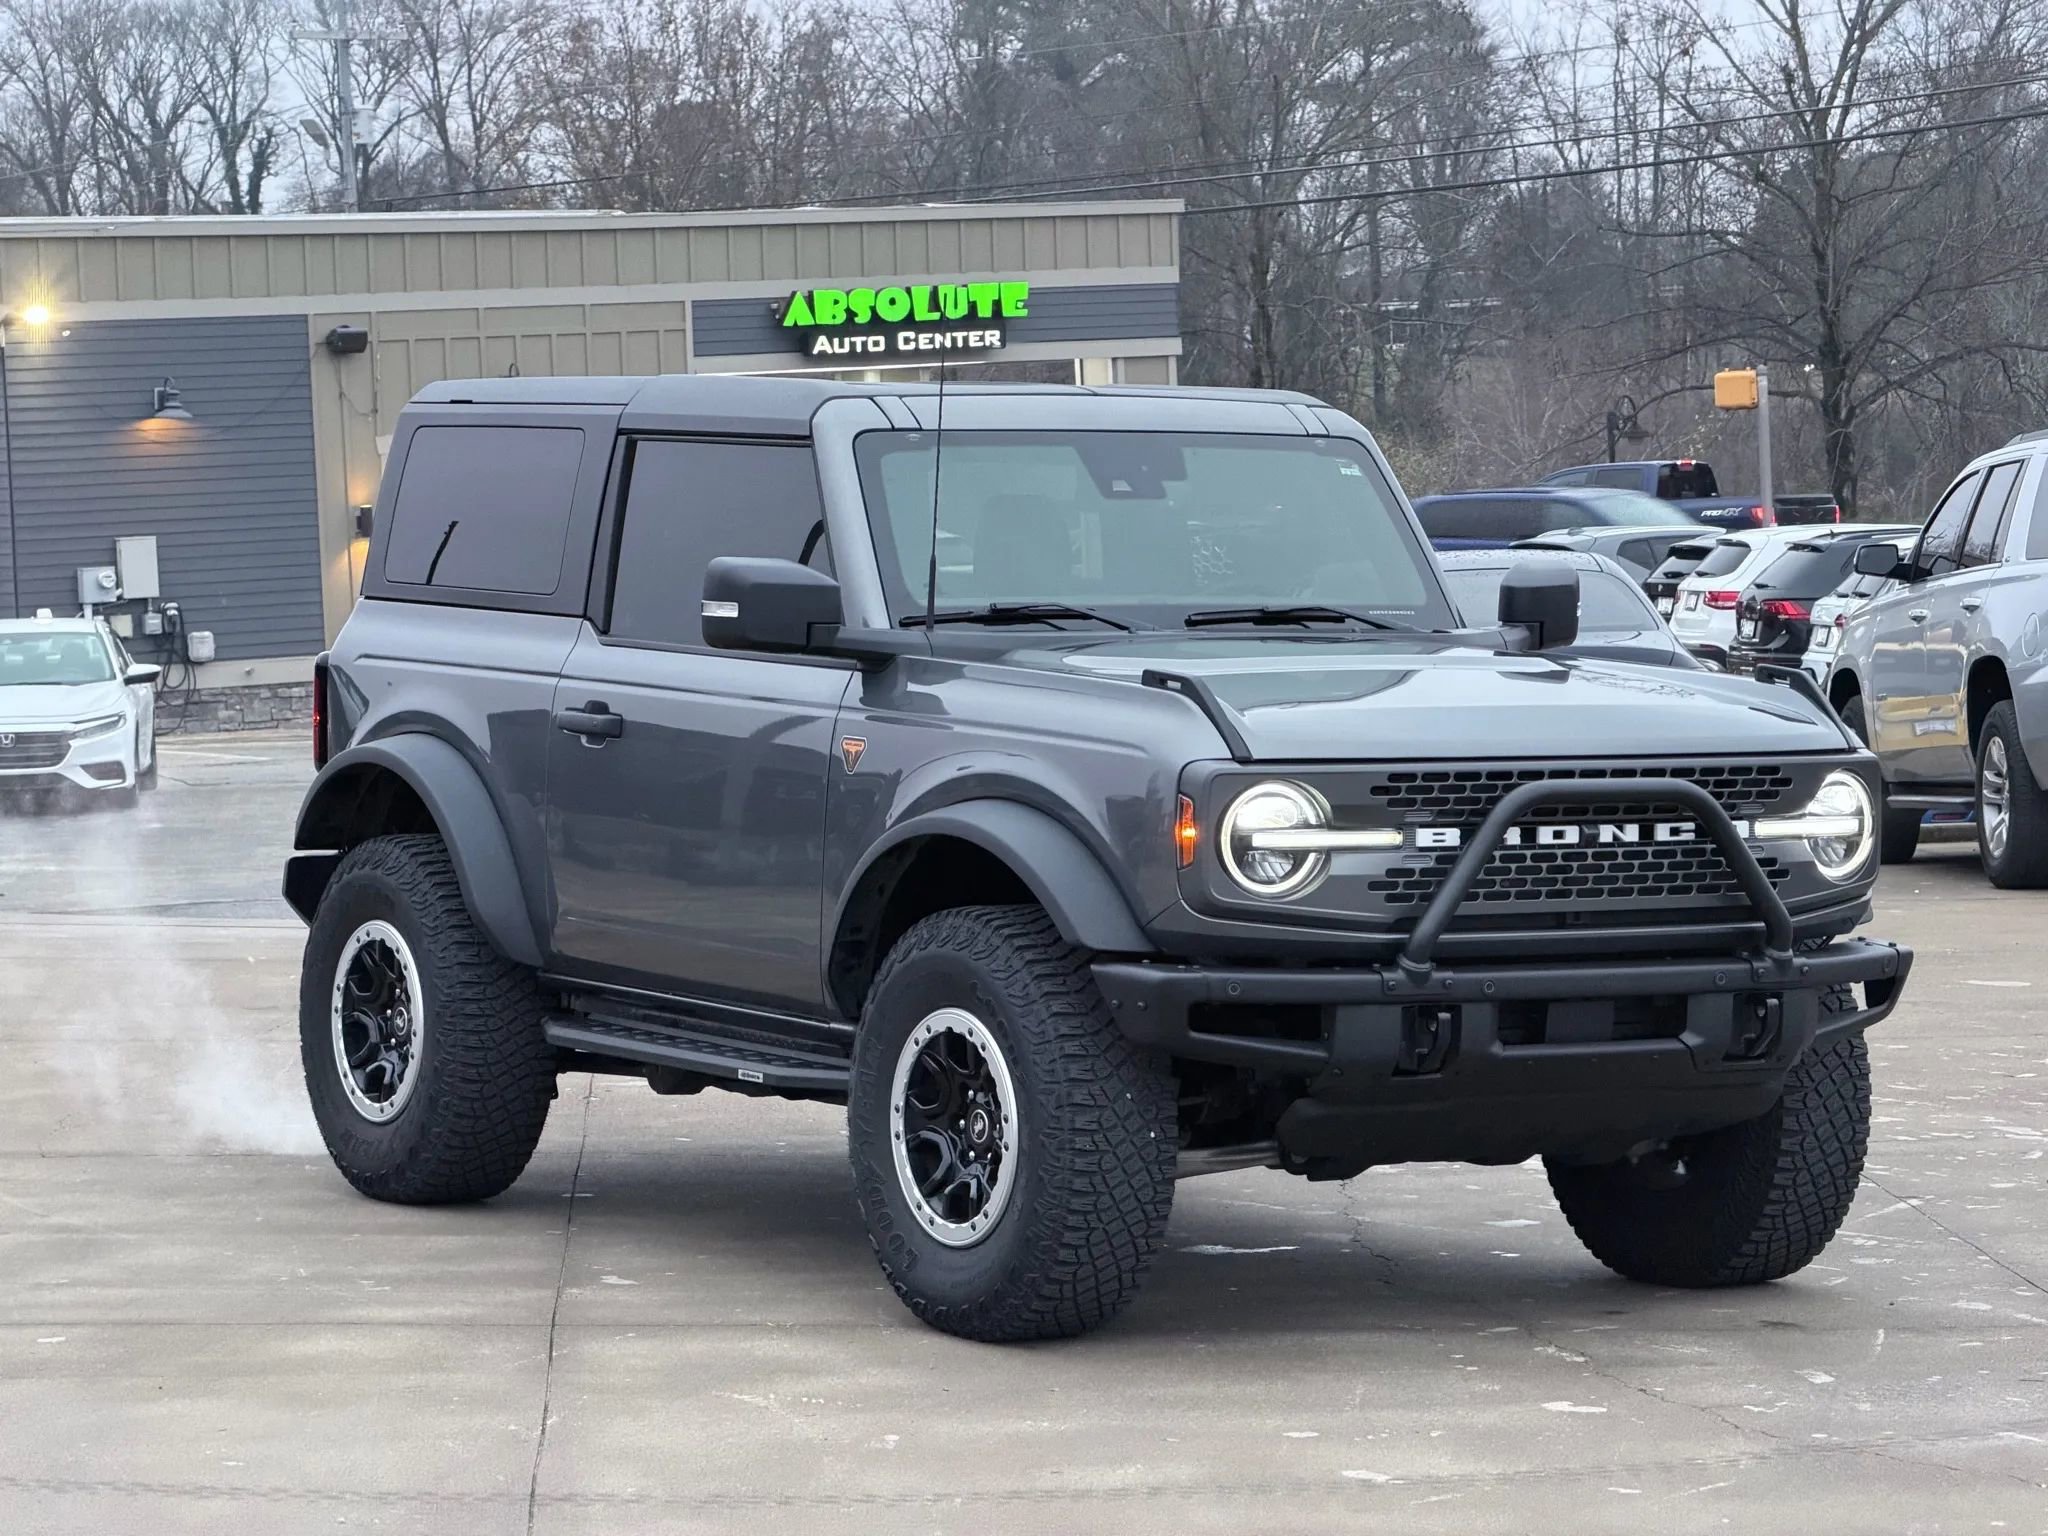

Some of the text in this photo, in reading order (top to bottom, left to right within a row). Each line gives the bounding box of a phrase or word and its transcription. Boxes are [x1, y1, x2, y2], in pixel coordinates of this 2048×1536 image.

[782, 281, 1029, 327] ABSOLUTE
[812, 329, 1001, 355] AUTO CENTER
